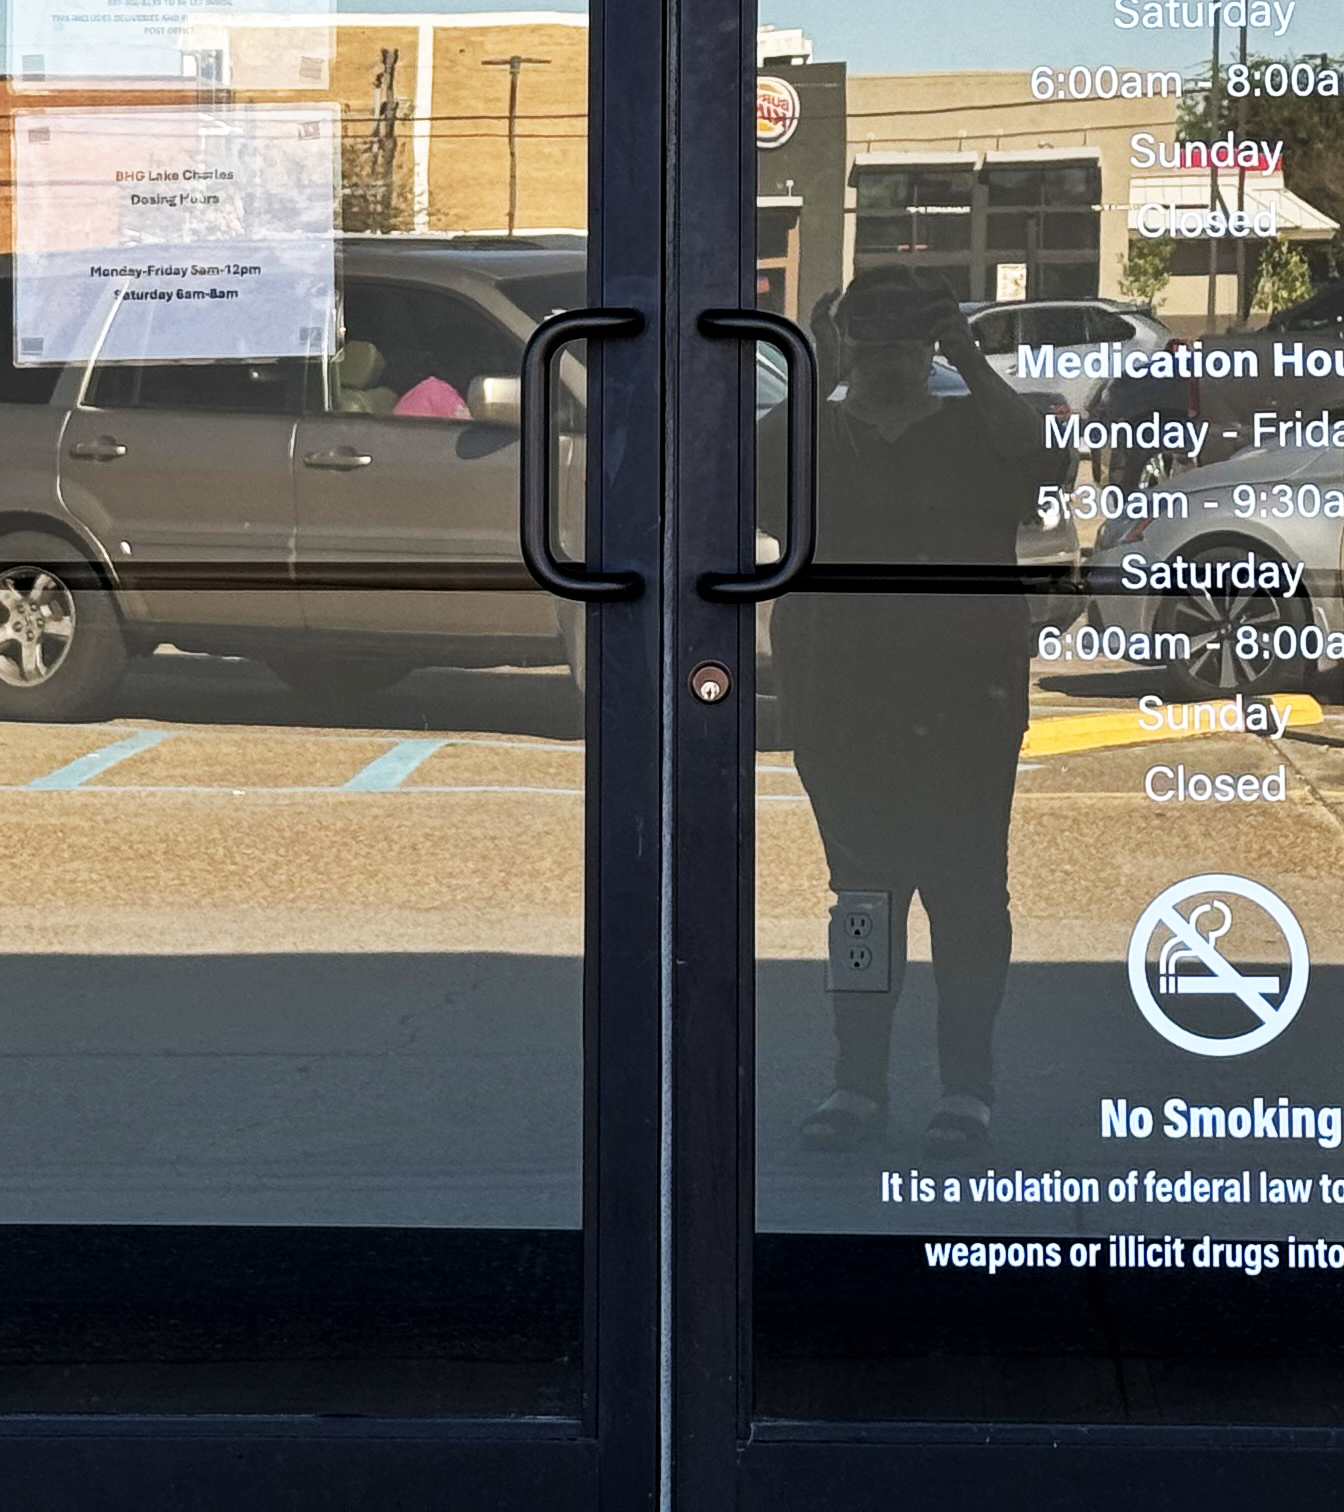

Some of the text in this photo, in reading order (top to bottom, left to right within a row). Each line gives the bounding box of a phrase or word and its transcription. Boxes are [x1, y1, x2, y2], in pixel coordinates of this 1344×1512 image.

[1029, 64, 1183, 100] 6:00am
[1130, 131, 1284, 177] Sunday
[115, 168, 234, 182] BHG Lake Charles
[130, 192, 220, 207] Dosing Hours
[1136, 200, 1278, 239] Closed
[90, 264, 262, 279] Monday-Friday 5am-12pm
[113, 289, 174, 303] Saturday
[1017, 342, 1259, 379] Medication
[1043, 411, 1209, 458] Monday
[1222, 430, 1238, 438] -
[1037, 484, 1189, 521] 5:30am
[1204, 501, 1219, 509] -
[1120, 551, 1305, 599] Saturday
[1037, 625, 1191, 661] 6:00am
[1206, 642, 1221, 650] -
[1137, 693, 1292, 740] Sunday
[1144, 764, 1287, 803] Closed
[1100, 1097, 1343, 1148] No Smoking
[881, 1170, 903, 1203] It
[910, 1169, 936, 1203] is
[943, 1177, 961, 1203] a
[969, 1169, 1100, 1203] violation
[1107, 1170, 1139, 1203] of
[1143, 1170, 1251, 1204] federal
[1259, 1171, 1313, 1204] law
[924, 1242, 1062, 1275] weapons
[1068, 1242, 1102, 1268] or
[1108, 1234, 1185, 1268] illicit
[1191, 1235, 1280, 1276] drugs
